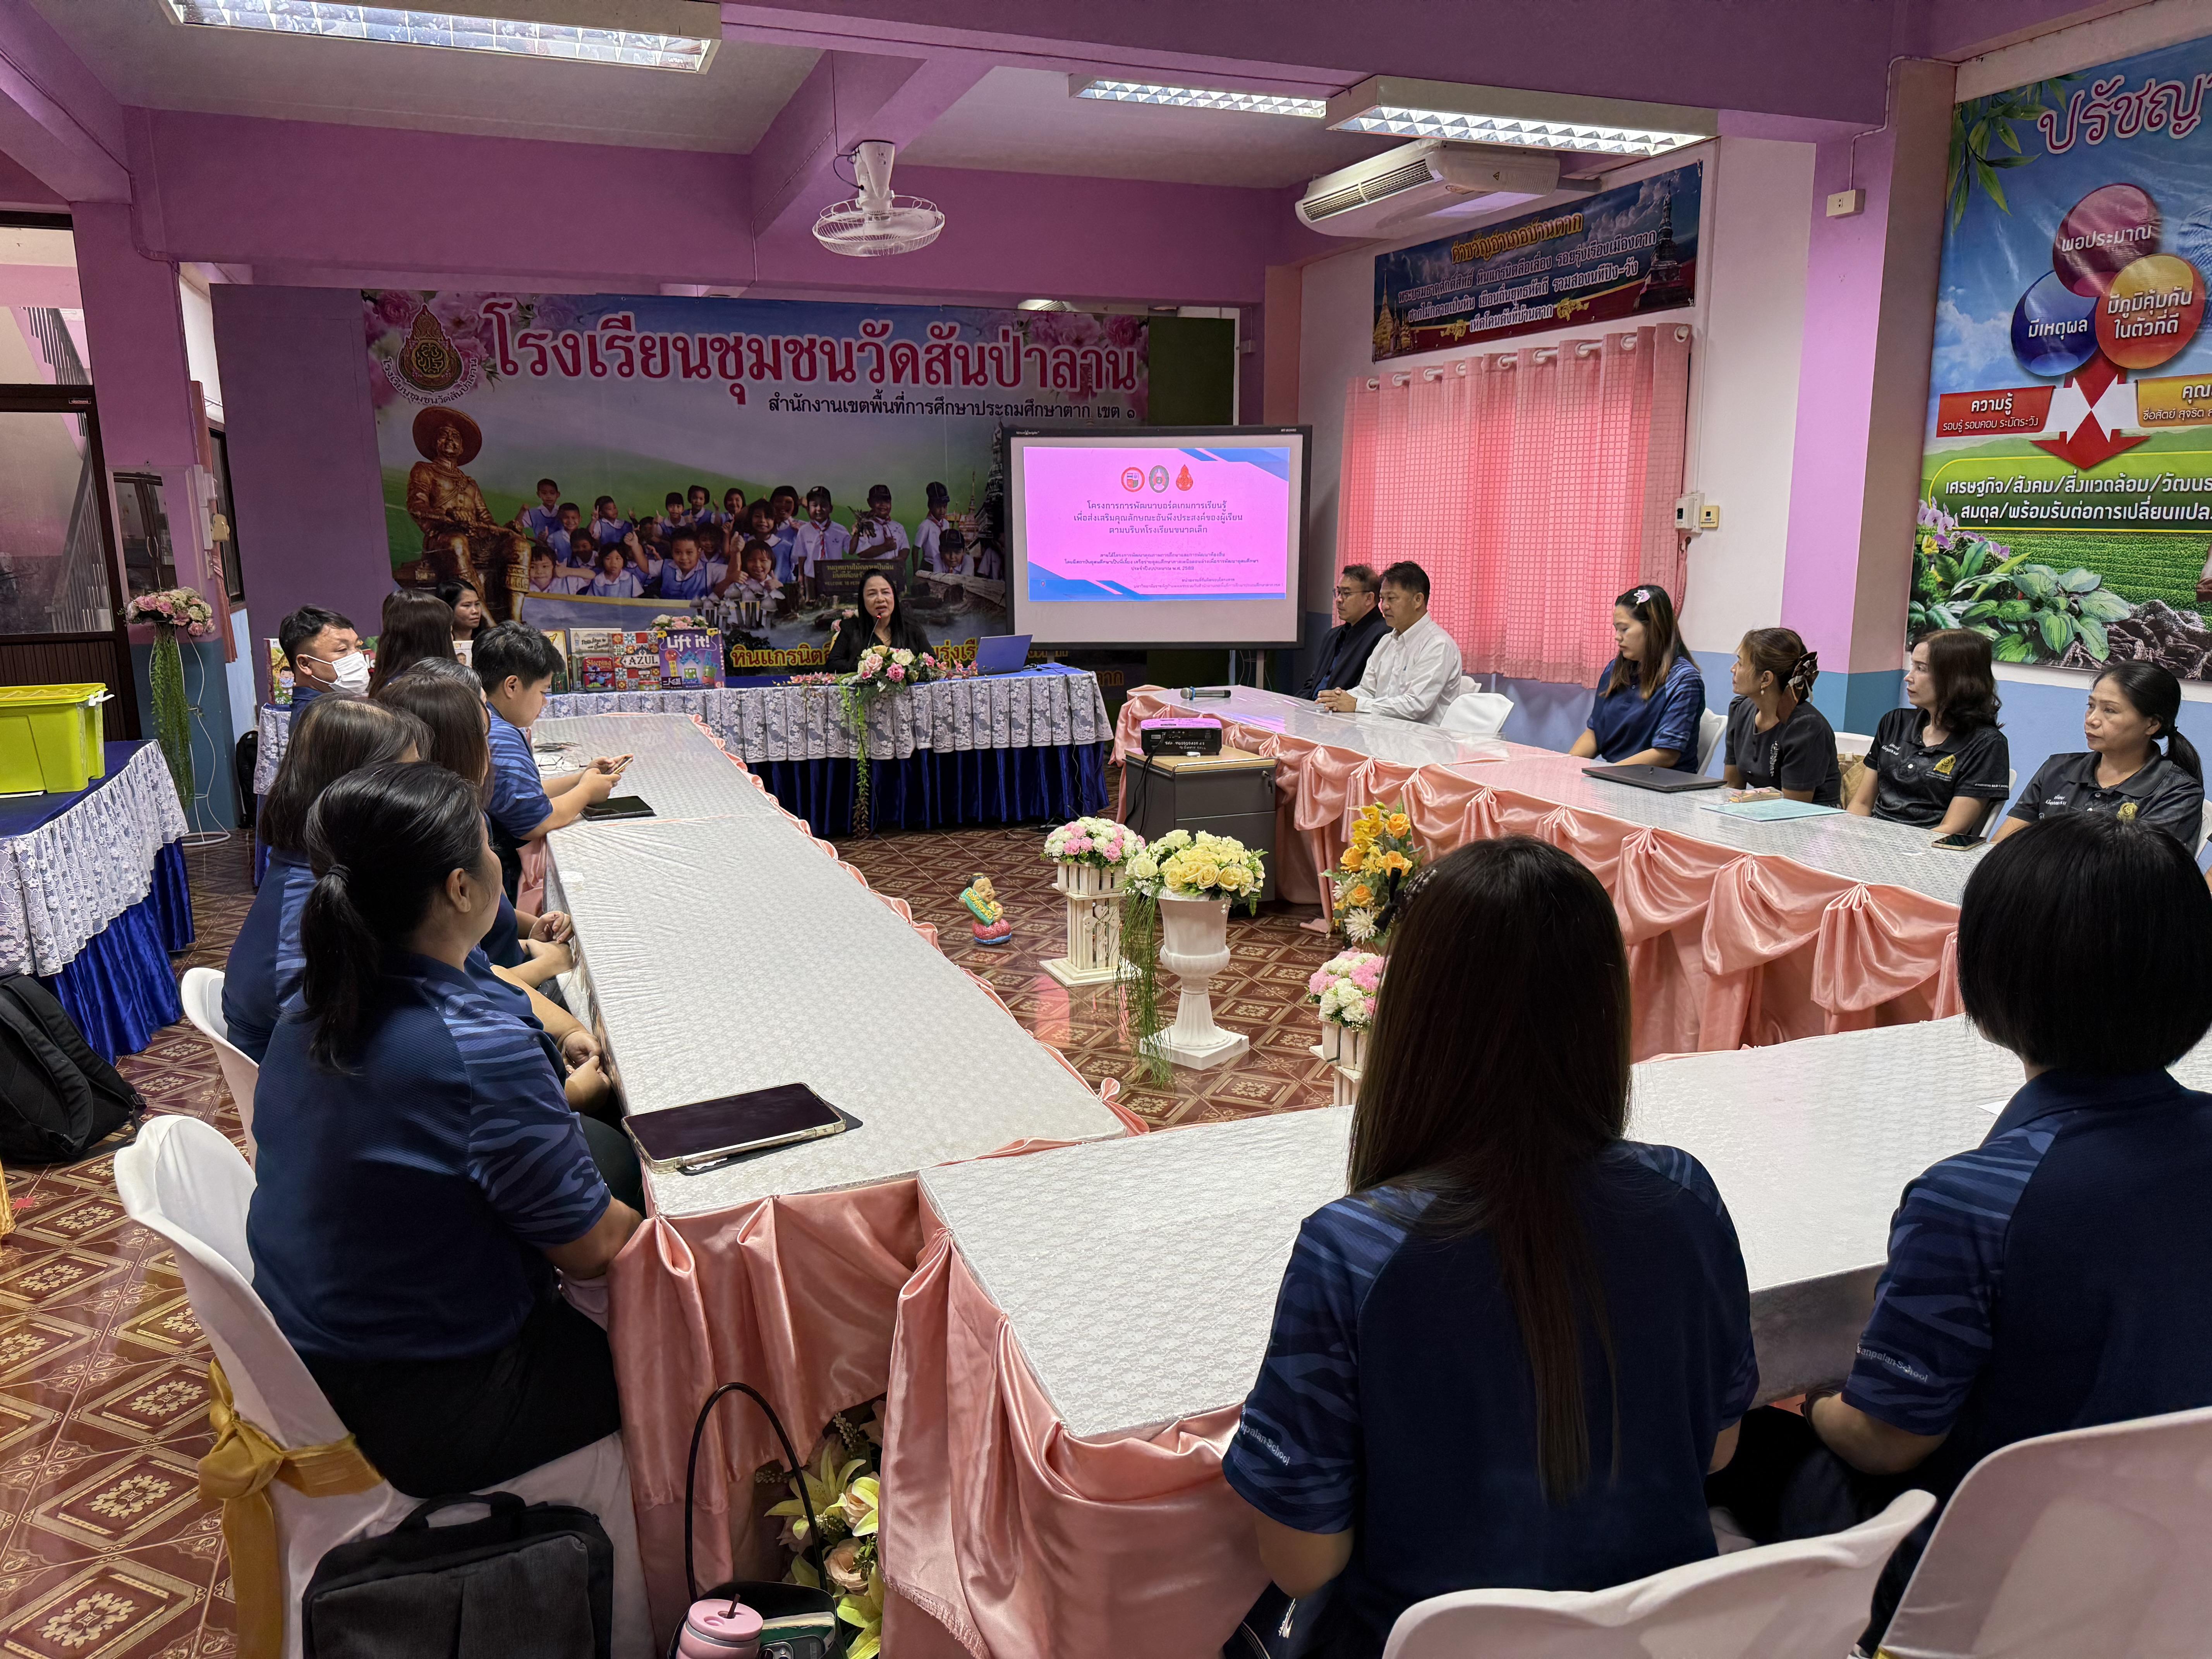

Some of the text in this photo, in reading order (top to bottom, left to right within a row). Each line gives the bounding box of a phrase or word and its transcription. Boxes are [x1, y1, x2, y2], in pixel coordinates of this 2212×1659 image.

[1451, 213, 1583, 264] คำขวัญอำเภอบ้านตาก
[1556, 230, 1657, 268] รอยรุ่งเรืองเมืองตาก
[2061, 224, 2152, 252] พอประมาณ
[2107, 287, 2193, 318] มีภูมิคุ้มกัน
[2028, 318, 2088, 341] มีเหตุผล
[2114, 313, 2179, 339] ในตัวที่ดี
[483, 301, 1137, 405] โรงเรียนชุมชนวัดสันป่าลาน
[769, 389, 1135, 419] สำนักงานเขตพื้นที่การศึกษาประถมศึกษาตาก เขต ๑
[1971, 392, 2013, 416] ความรู้
[2182, 384, 2212, 404] คุณ
[1943, 416, 2039, 433] รอบรู้ รอบคอบ ระมัดระวัง
[2179, 408, 2204, 421] สุจริต
[1074, 511, 1243, 524] เพื่อส่งเสริมคุณลักษณะอันพึงประสงค์ของผู้เรียน
[1087, 500, 1227, 512] โครงการการพัฒนาบอร์ดเกมการเรียนรู้
[1961, 495, 2212, 524] สมดุล/พร้อมรับต่อการเปลี่ยนแปล
[1109, 525, 1207, 534] ตามบริบทโรงเรียนขนาดเล็ก
[667, 634, 710, 652] Lift it!
[586, 659, 612, 669] Sleeping
[629, 656, 658, 665] AZUL
